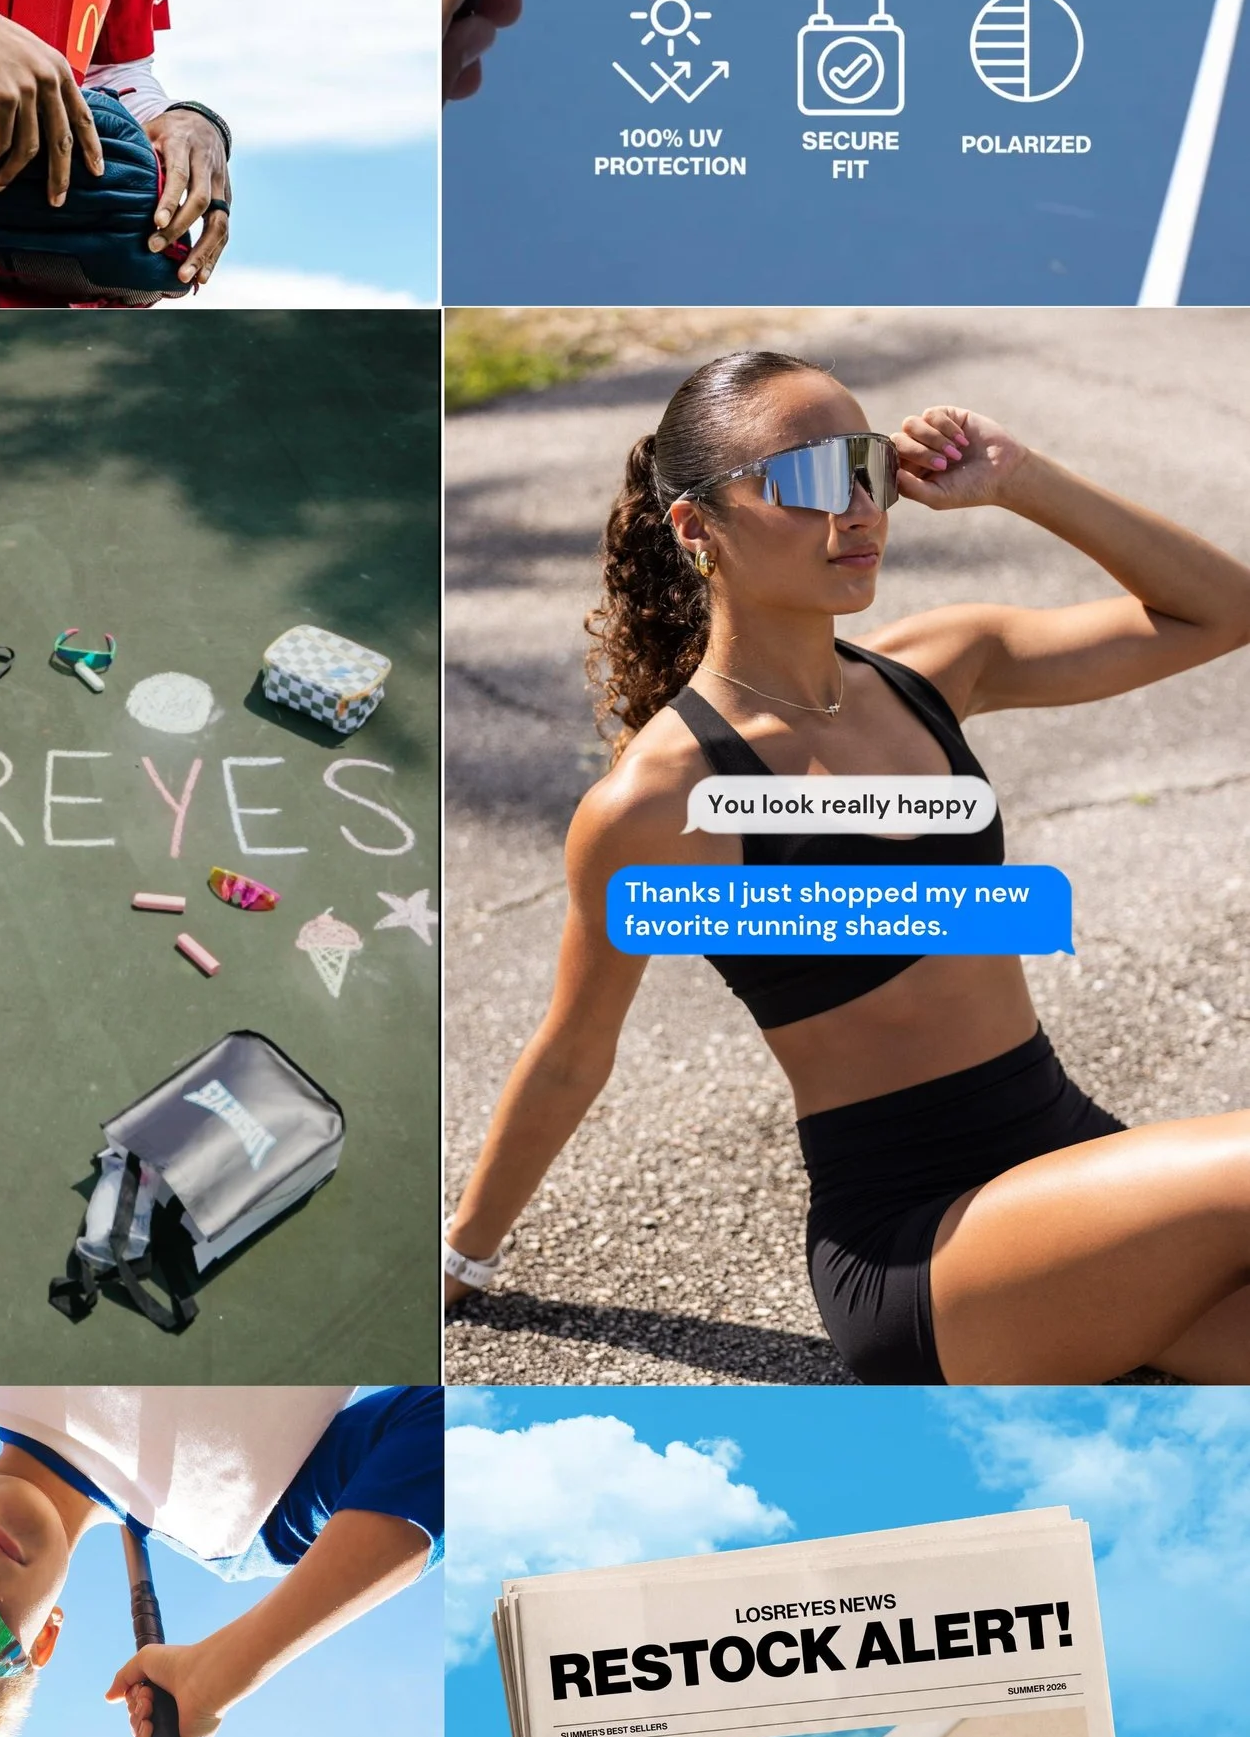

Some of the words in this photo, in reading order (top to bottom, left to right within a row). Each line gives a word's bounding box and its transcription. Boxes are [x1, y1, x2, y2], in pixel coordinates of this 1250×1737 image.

[735, 1600, 838, 1624] LOSREYES
[839, 1593, 897, 1615] NEWS
[549, 1625, 846, 1701] RESTOCK
[855, 1601, 1074, 1669] ALERT!
[1007, 1684, 1045, 1695] SUMMER
[1046, 1682, 1067, 1692] 2026
[606, 1725, 628, 1736] BEST
[629, 1722, 668, 1734] SELLERS
